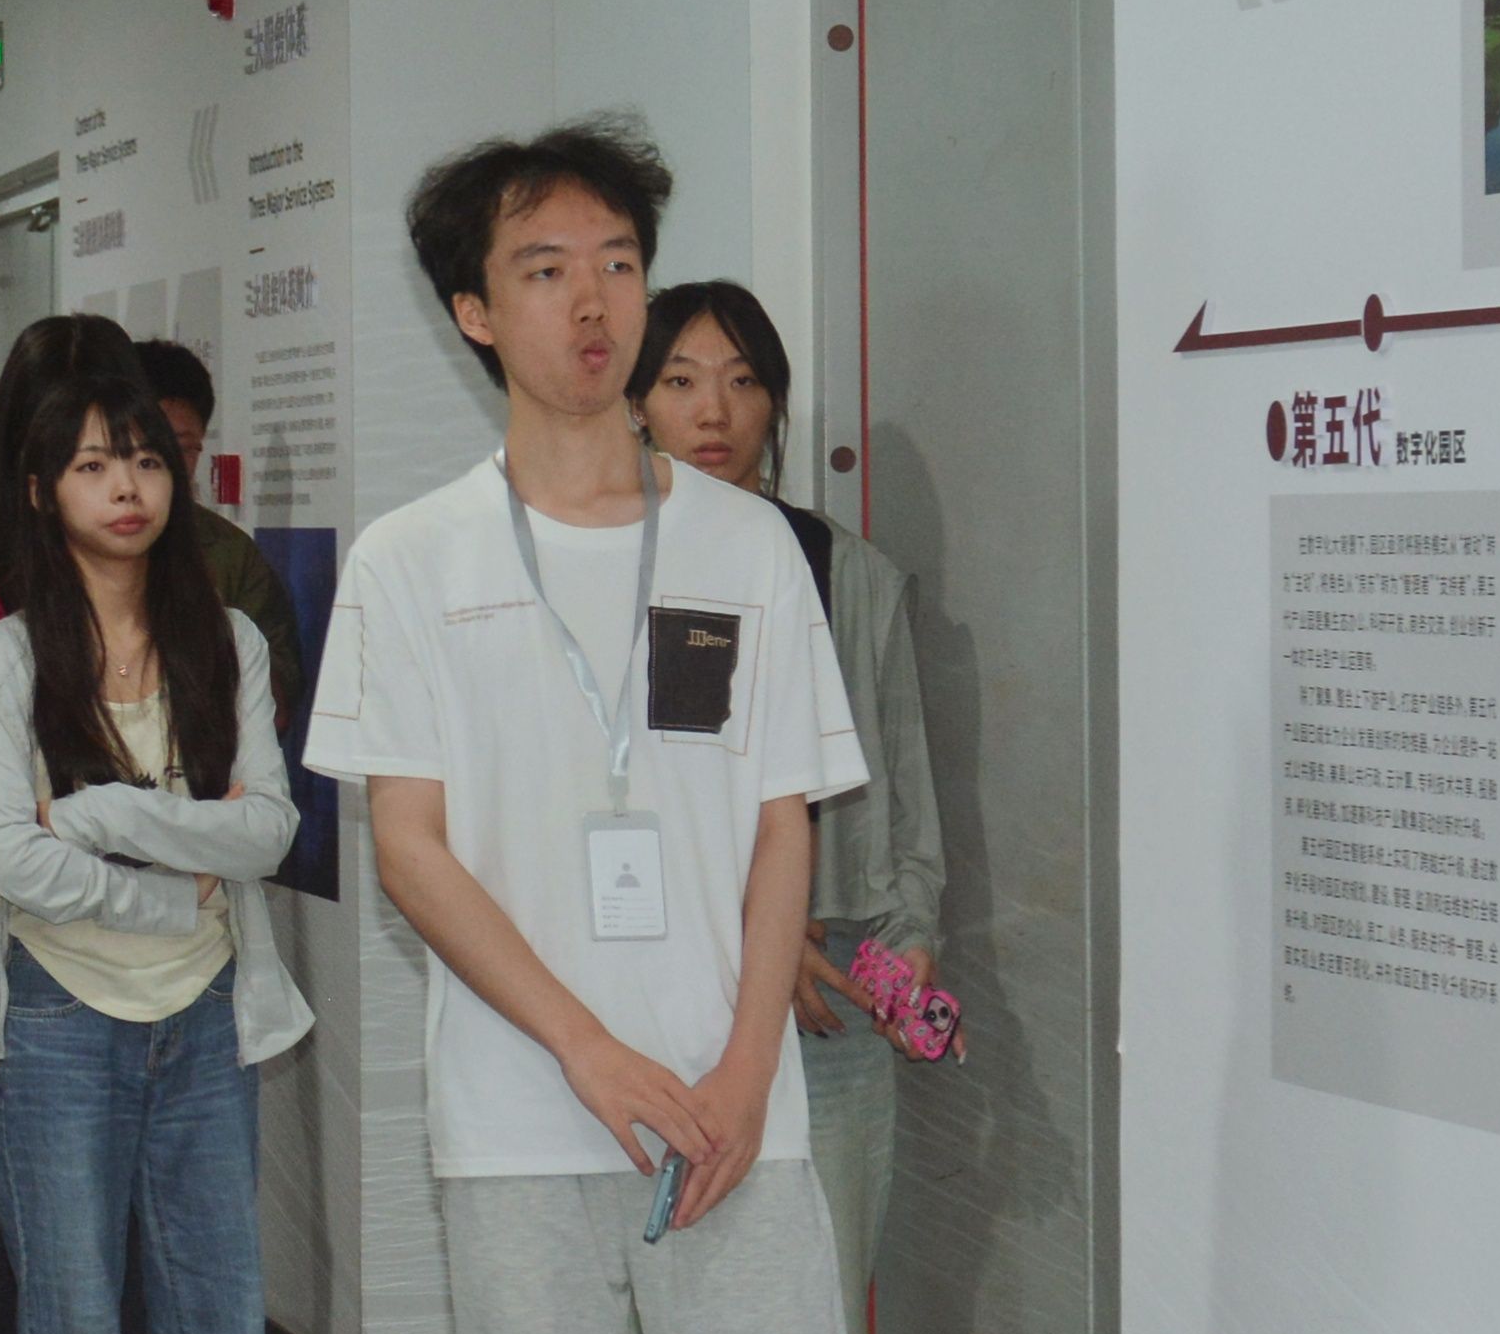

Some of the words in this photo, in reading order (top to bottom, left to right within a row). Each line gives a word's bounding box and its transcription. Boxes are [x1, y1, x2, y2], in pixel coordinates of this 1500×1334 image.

[1291, 387, 1381, 469] 第五代
[1396, 430, 1467, 465] 数字化园区
